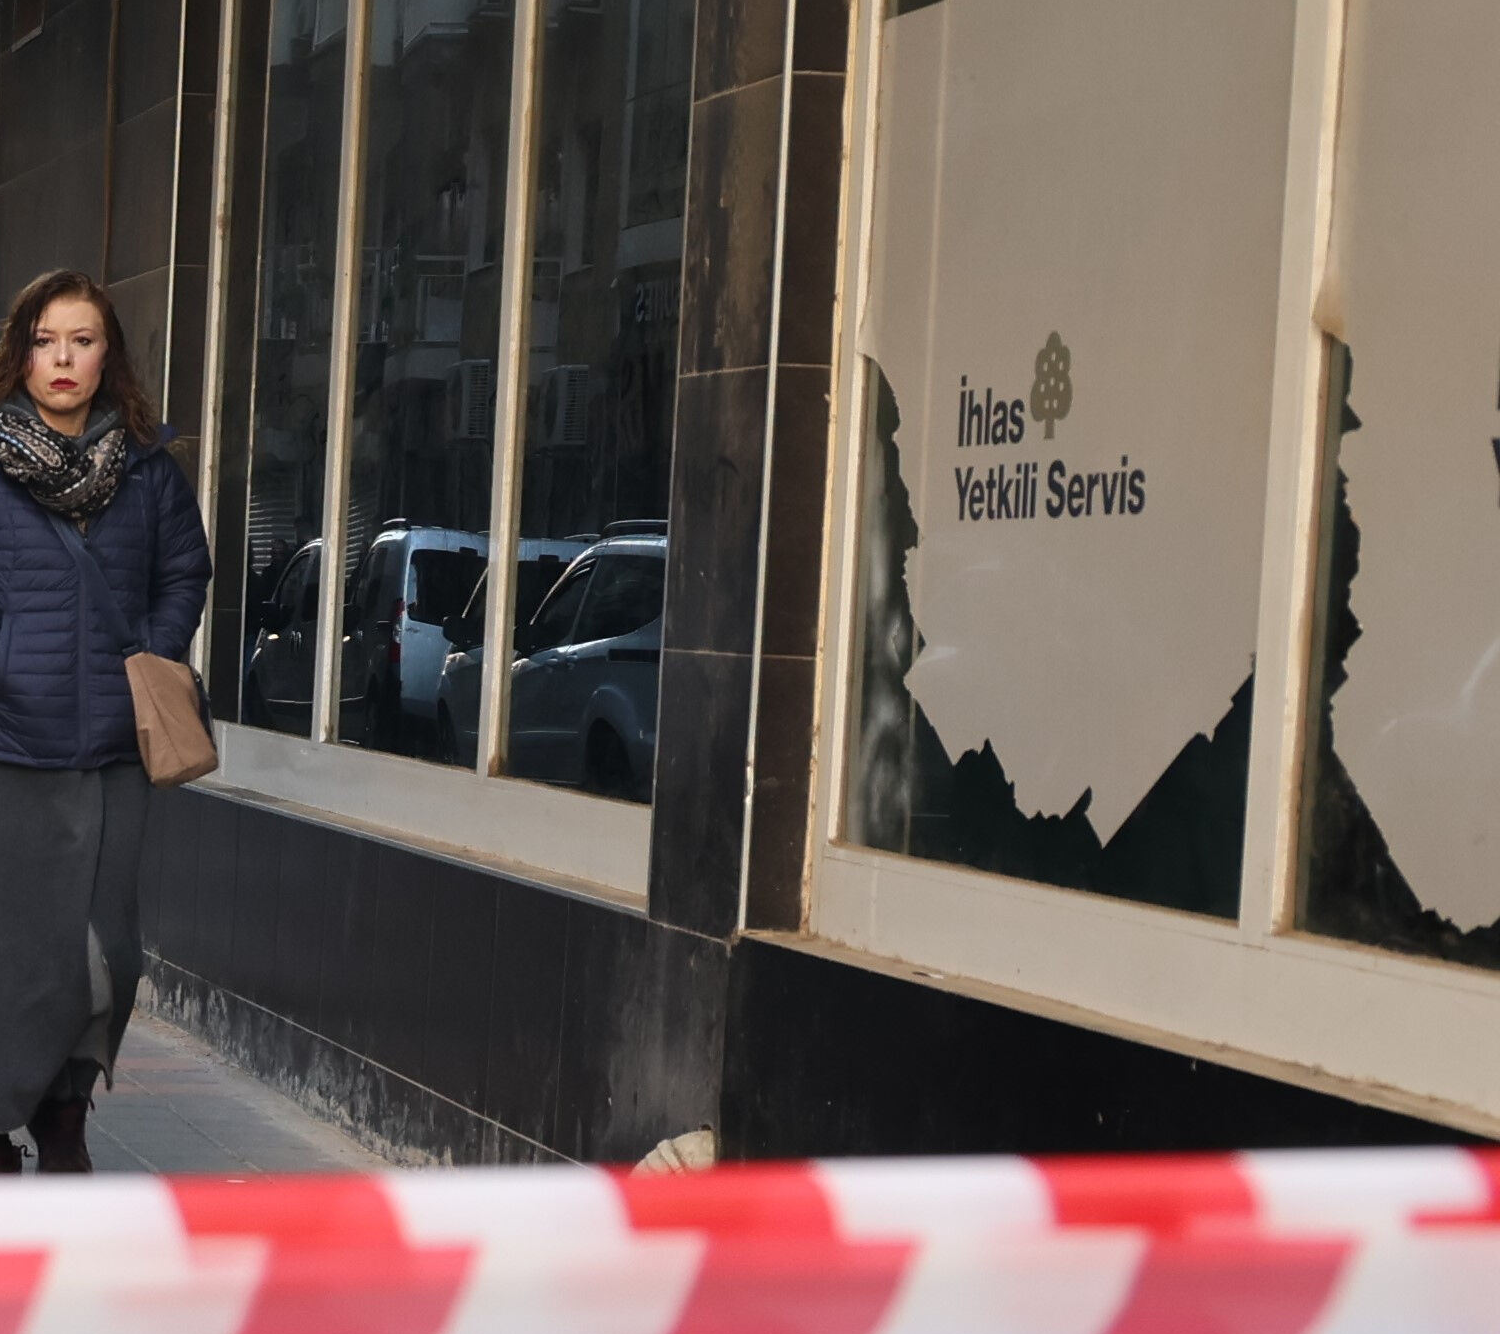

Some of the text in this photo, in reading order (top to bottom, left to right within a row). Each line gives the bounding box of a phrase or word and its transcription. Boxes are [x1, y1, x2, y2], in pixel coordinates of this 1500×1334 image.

[956, 374, 1026, 448] İhlas
[954, 454, 1146, 521] Yetkili Servis
